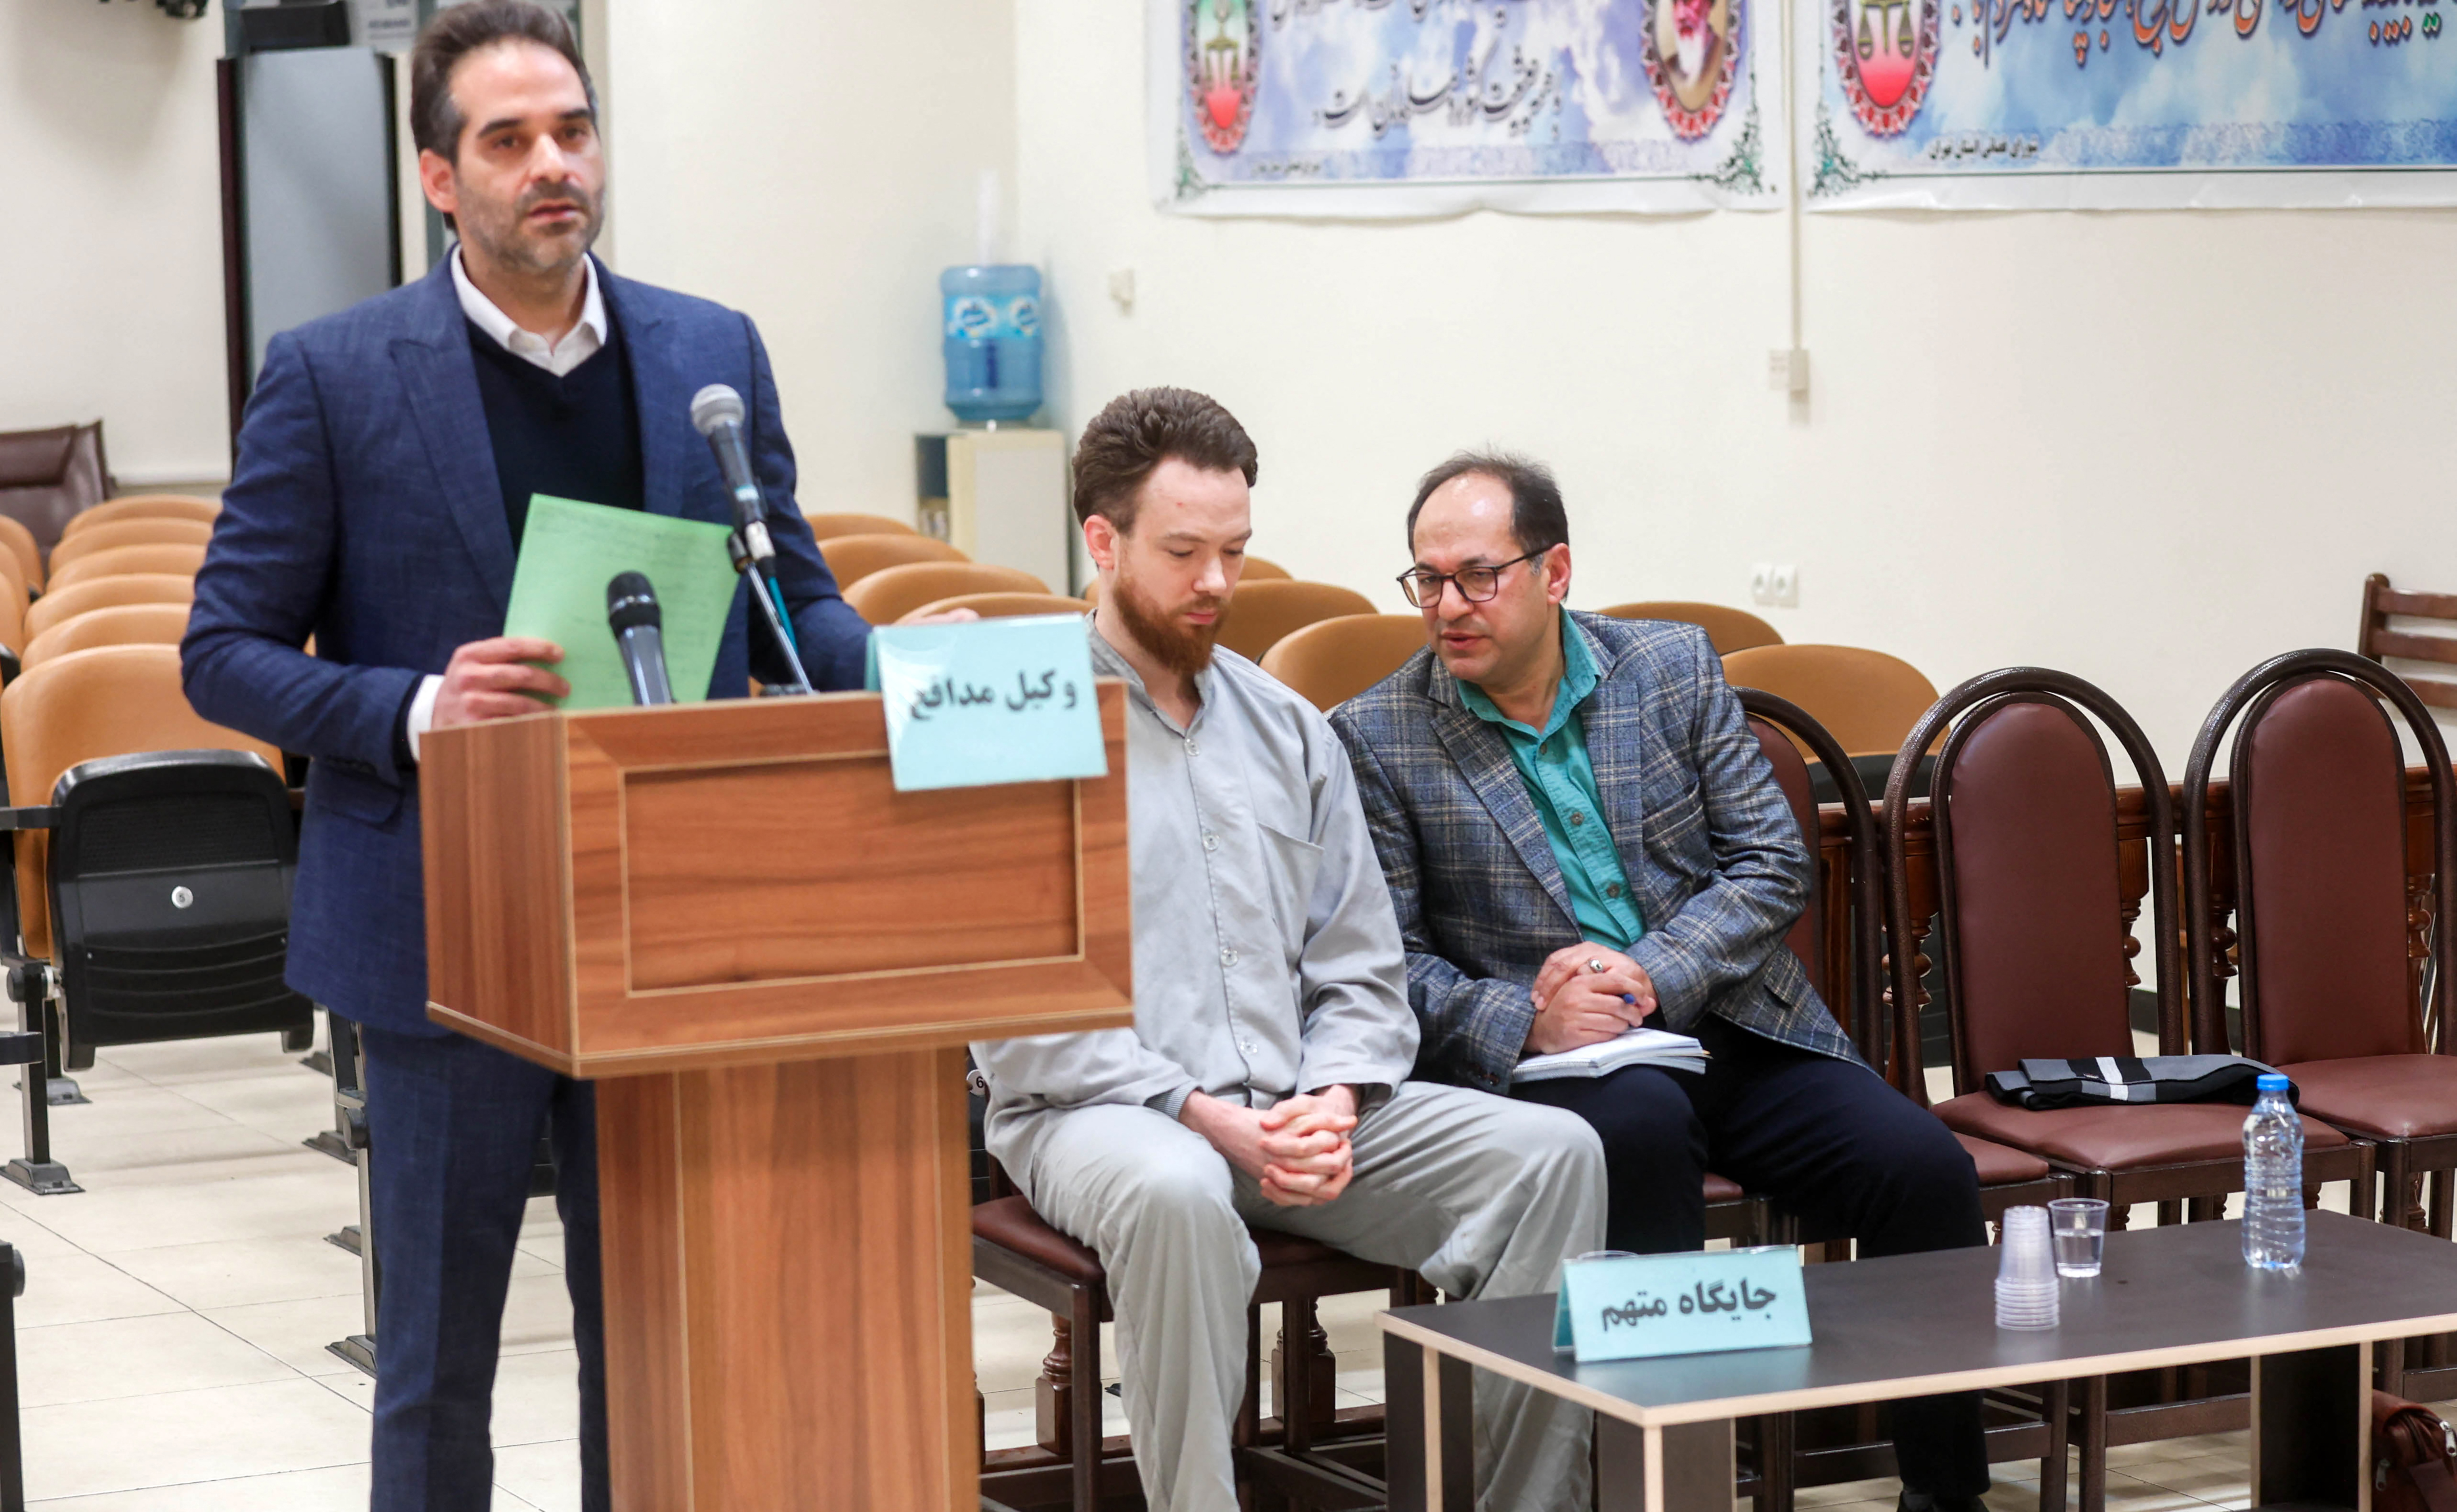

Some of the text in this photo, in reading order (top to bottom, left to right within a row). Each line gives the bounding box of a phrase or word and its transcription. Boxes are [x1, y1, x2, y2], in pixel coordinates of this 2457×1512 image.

[910, 669, 1078, 721] وکیل مدافع
[976, 1076, 984, 1089] 6
[1602, 1276, 1777, 1332] جایگاه متهم
